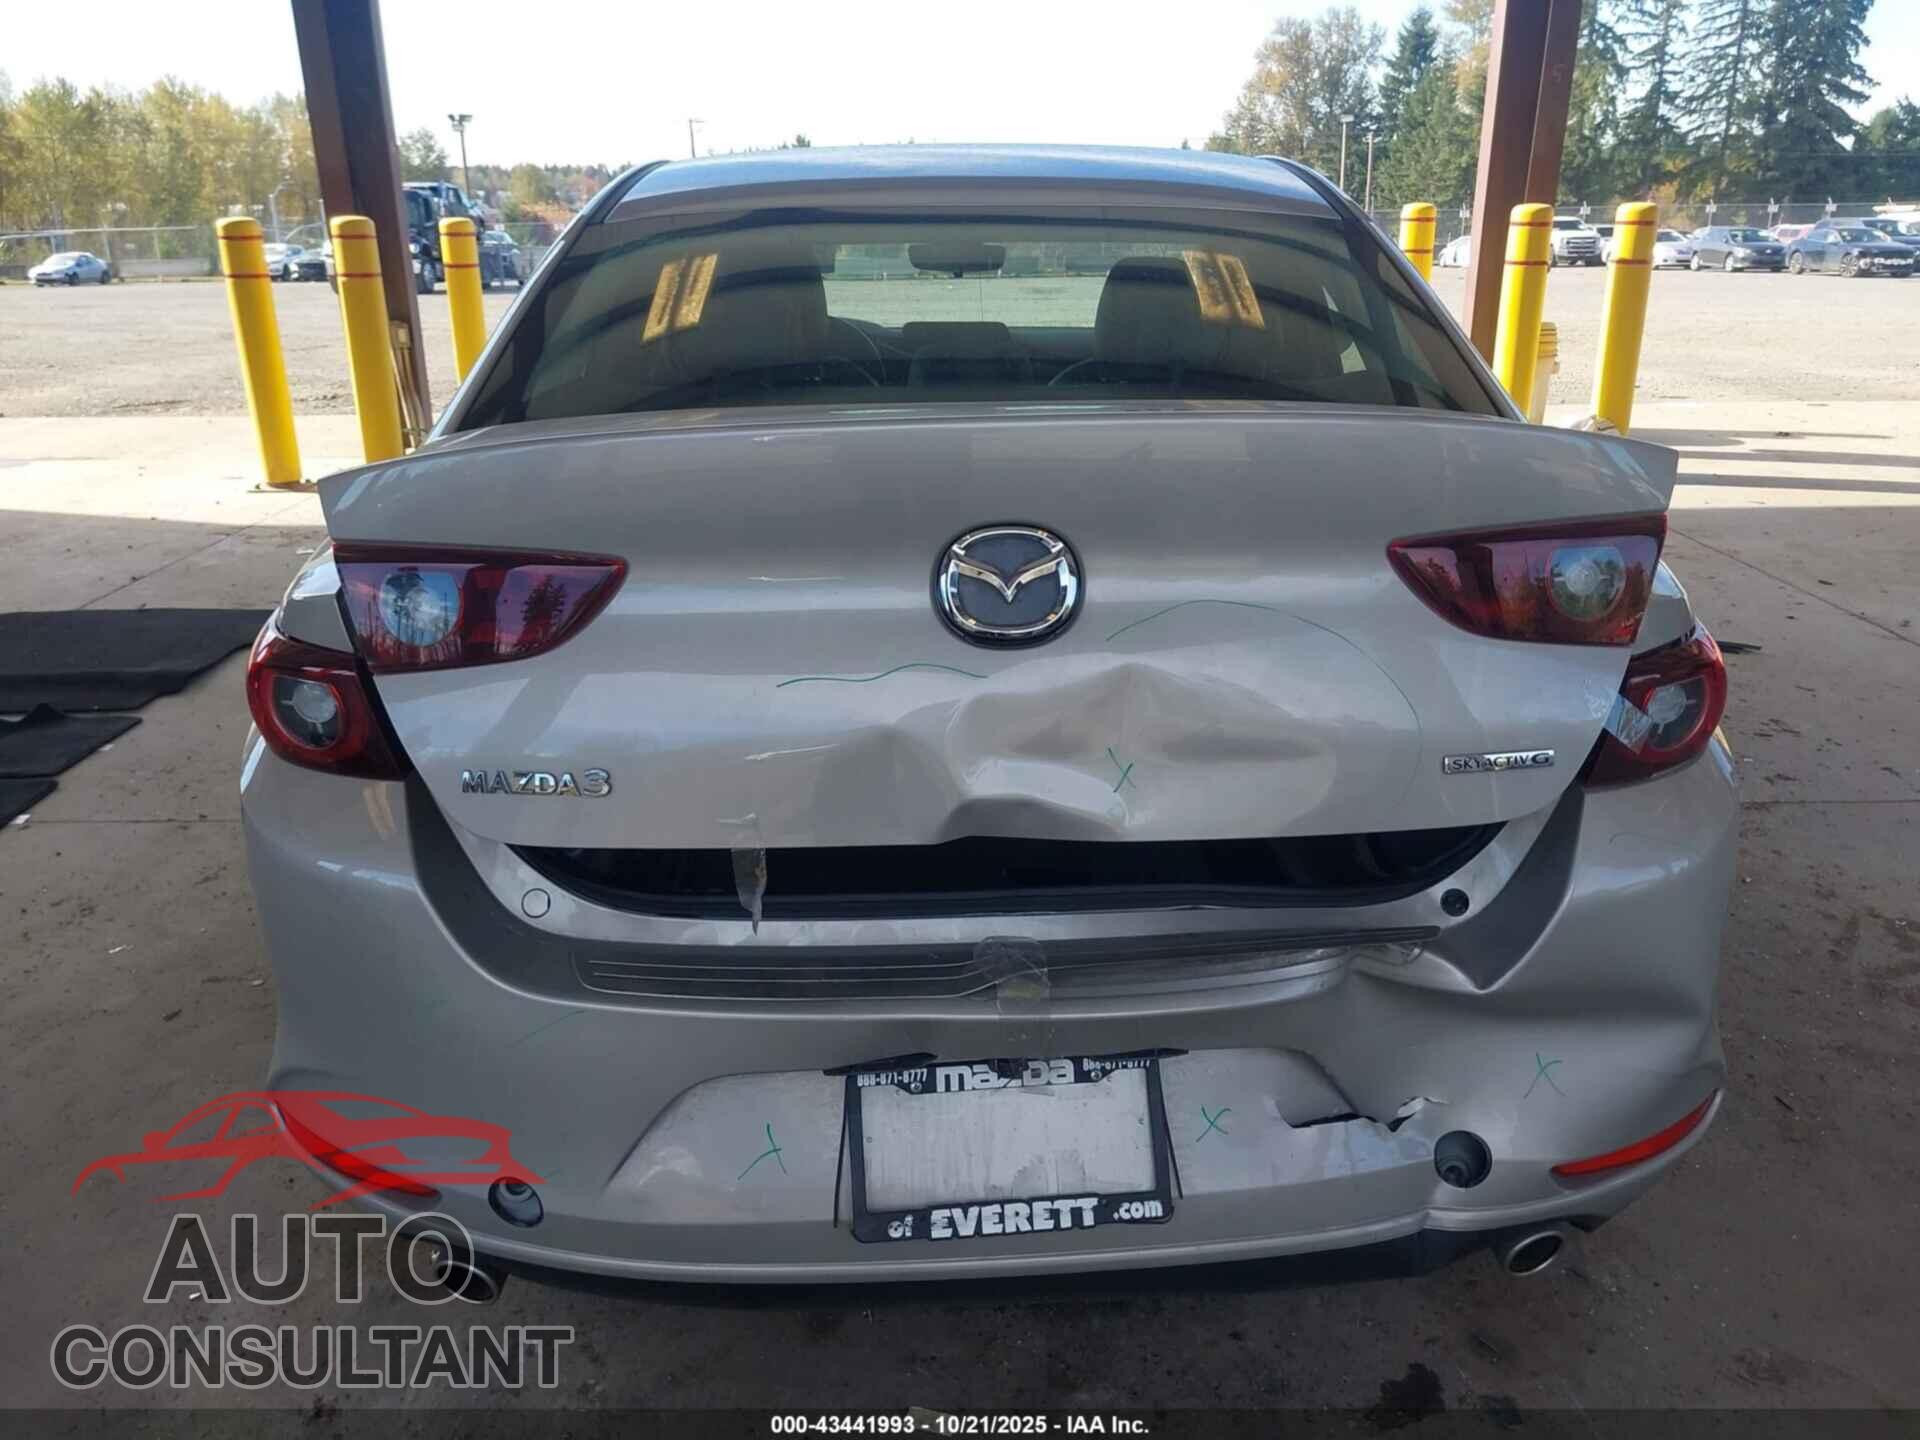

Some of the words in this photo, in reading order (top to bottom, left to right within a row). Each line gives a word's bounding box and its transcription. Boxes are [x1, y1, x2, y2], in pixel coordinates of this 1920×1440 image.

[461, 768, 612, 797] MAZDA3
[888, 1214, 913, 1238] of
[930, 1197, 1098, 1239] EVERETT
[1112, 1200, 1163, 1221] .com
